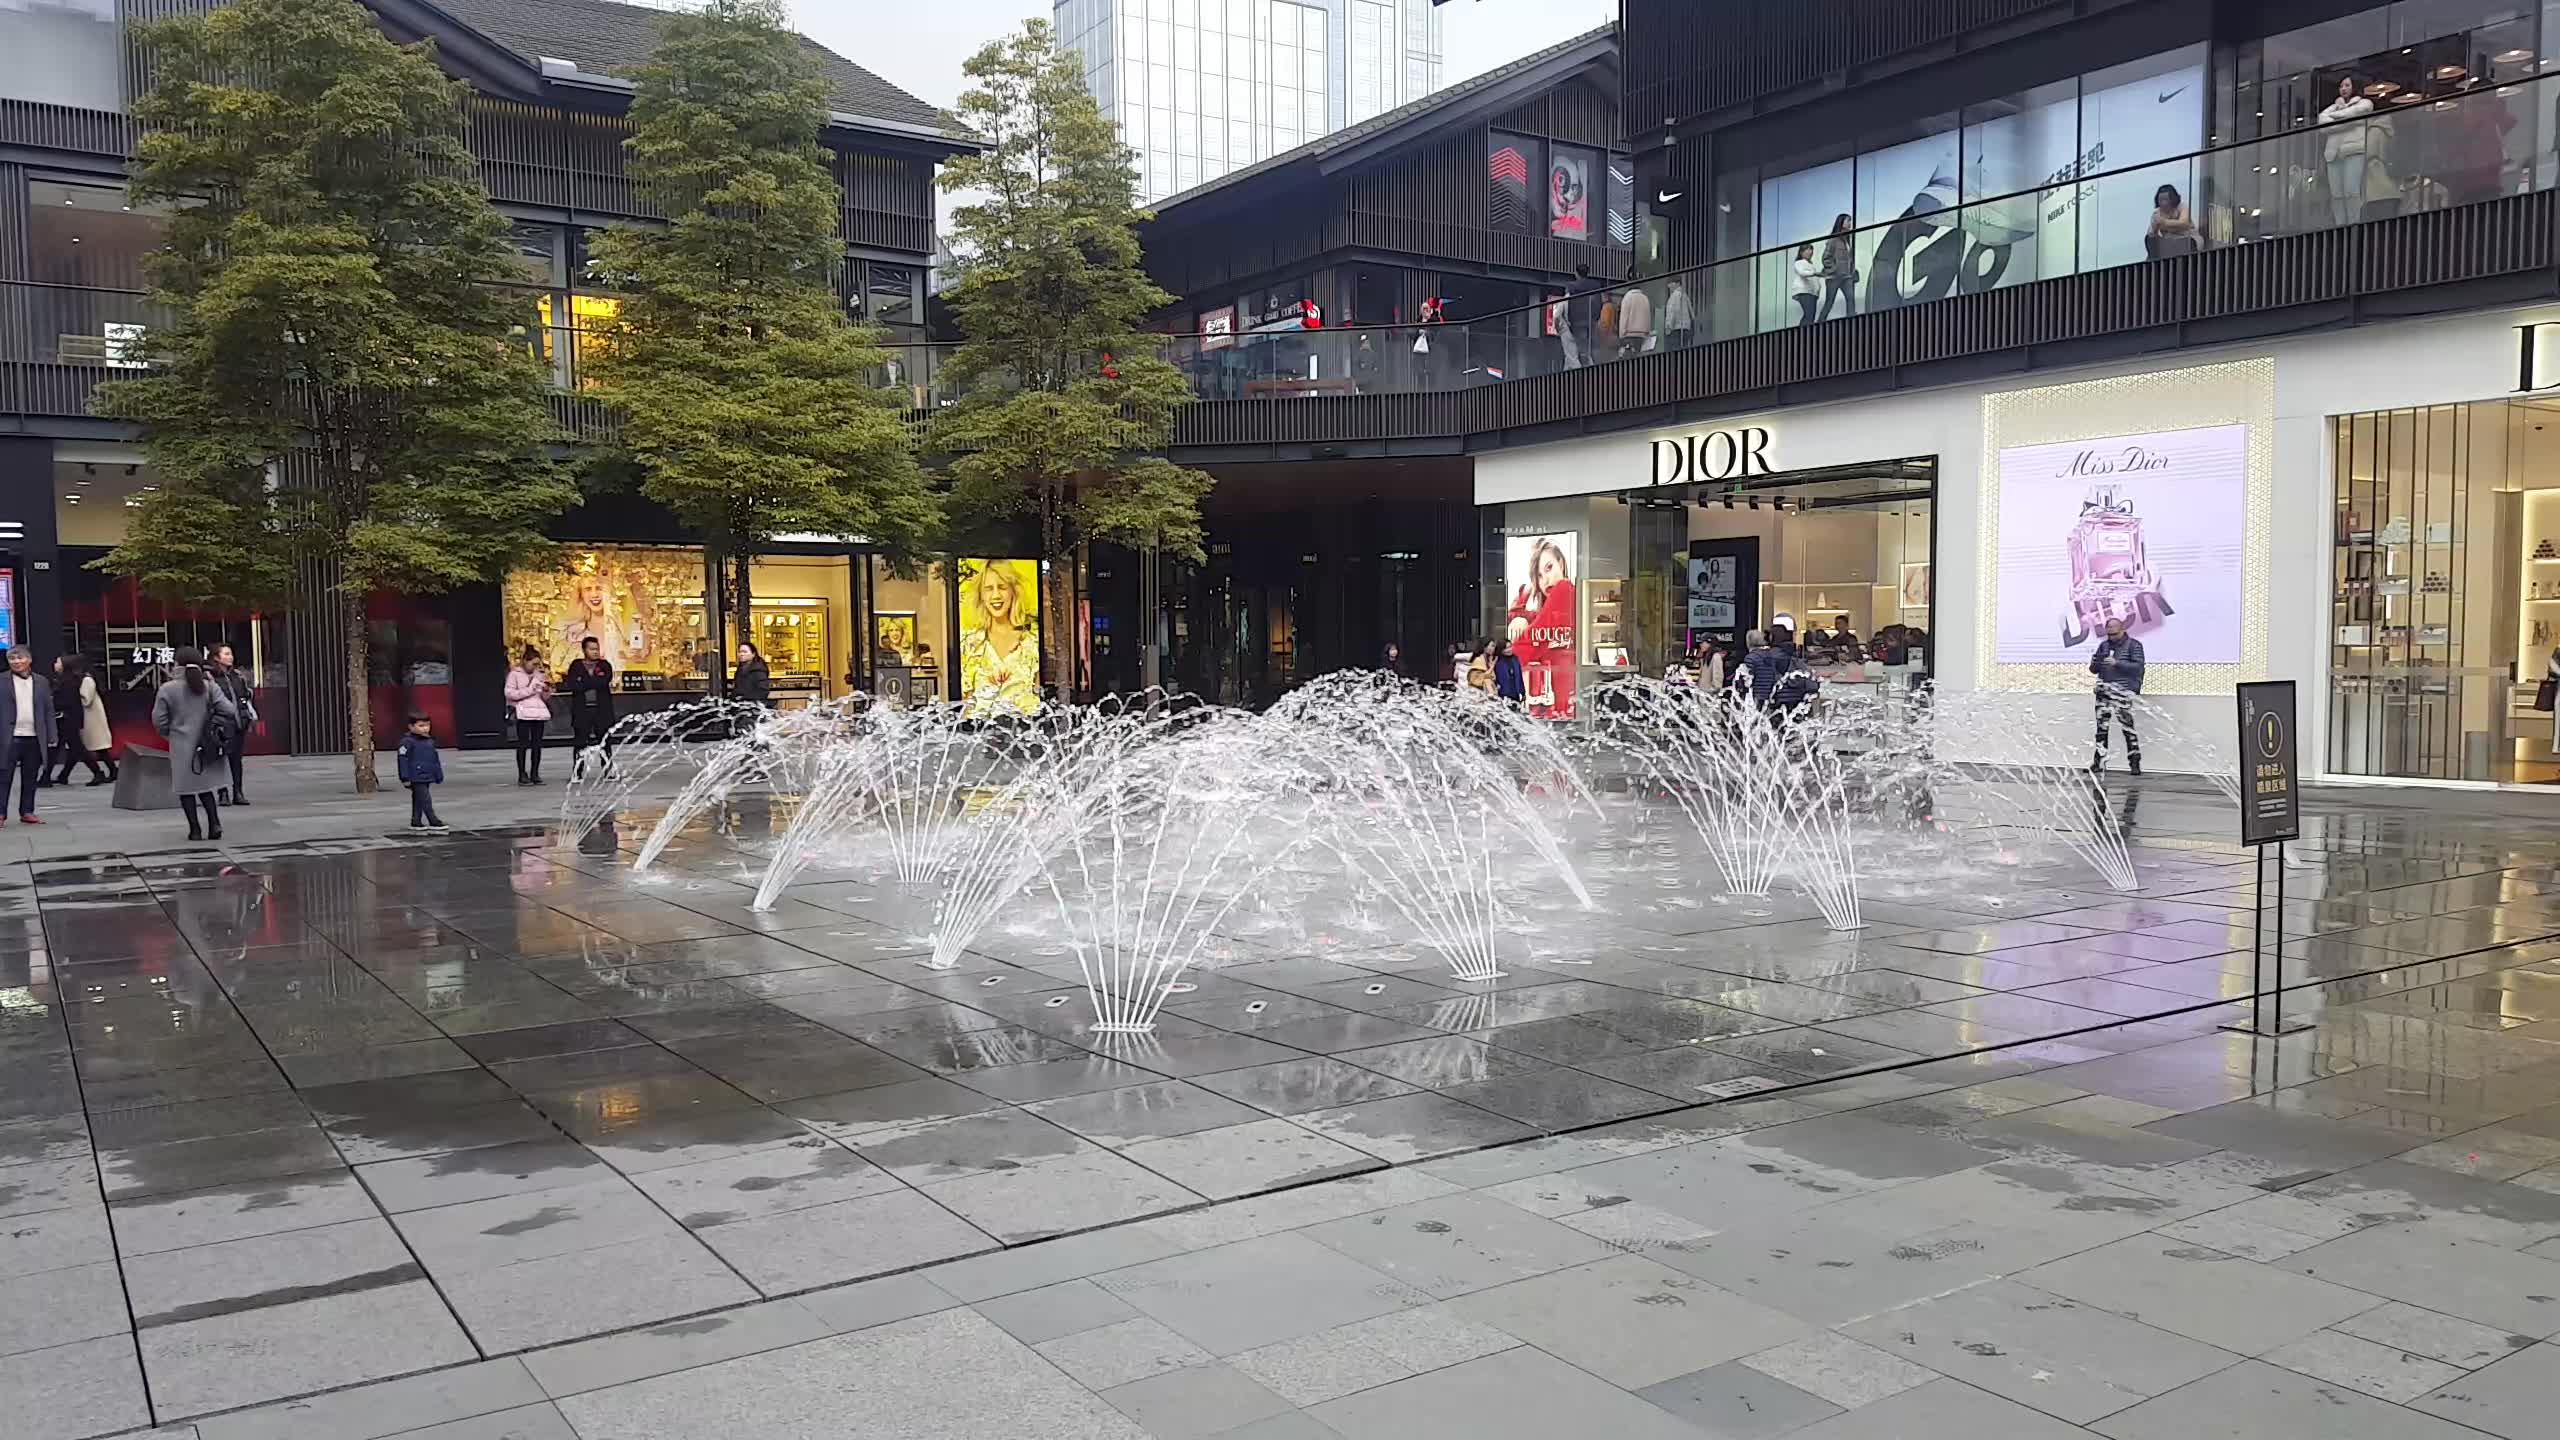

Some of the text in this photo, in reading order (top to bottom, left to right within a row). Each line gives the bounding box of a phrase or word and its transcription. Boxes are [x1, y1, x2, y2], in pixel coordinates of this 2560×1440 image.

[1649, 428, 1774, 486] DIOR
[2055, 446, 2169, 478] Miss Dior
[1531, 627, 1571, 641] ROUGE
